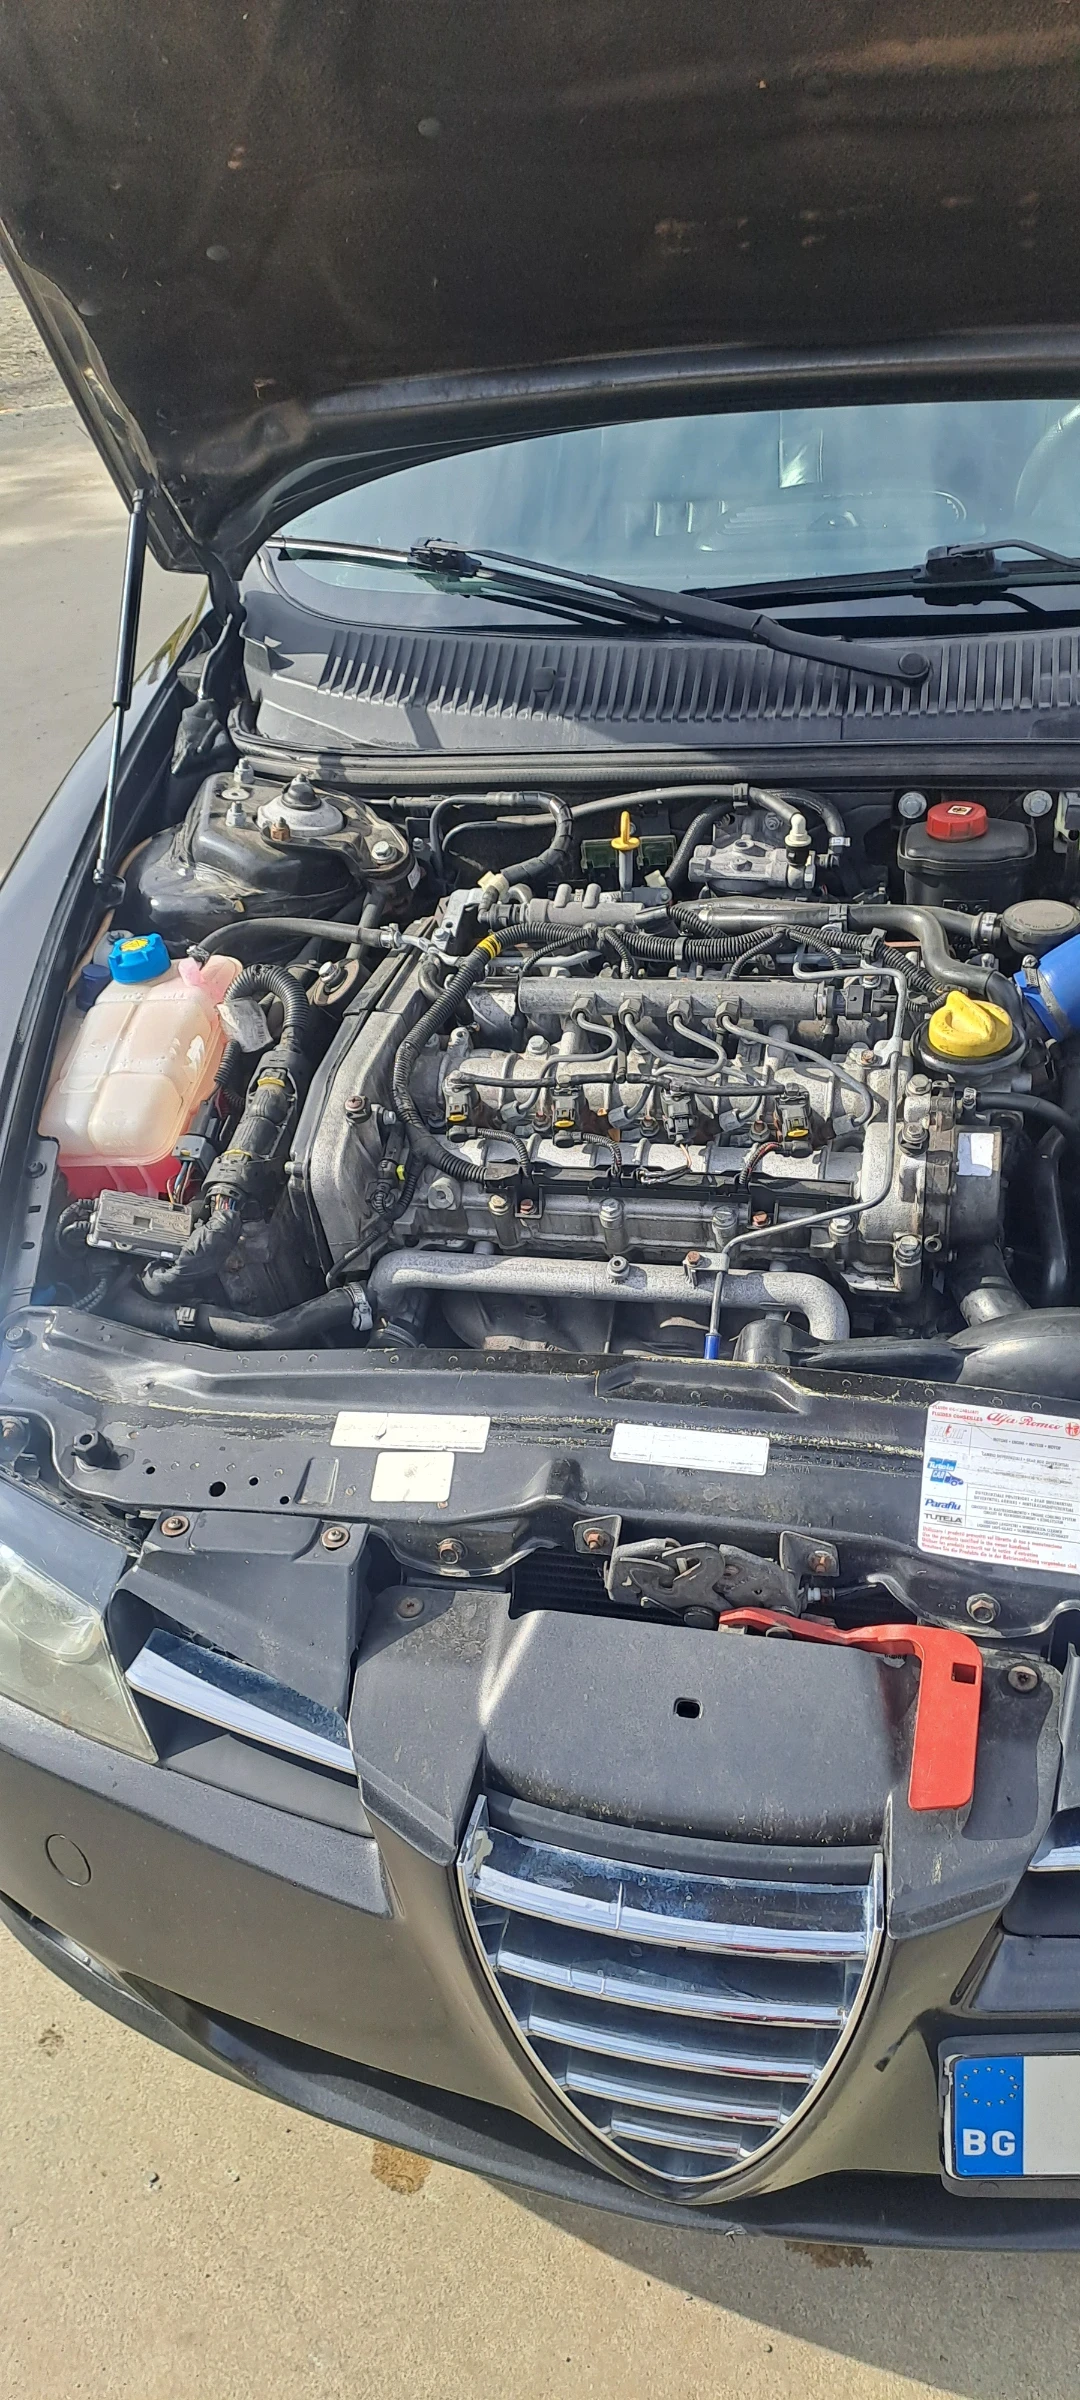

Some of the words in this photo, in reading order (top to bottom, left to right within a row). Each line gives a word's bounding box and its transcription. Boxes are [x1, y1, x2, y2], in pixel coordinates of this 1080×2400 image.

[986, 1412, 1017, 1426] Alfa
[1018, 1416, 1063, 1431] Romeo
[924, 1498, 962, 1511] Paraflu
[924, 1512, 961, 1523] TUTELA
[962, 2128, 1016, 2157] BG
